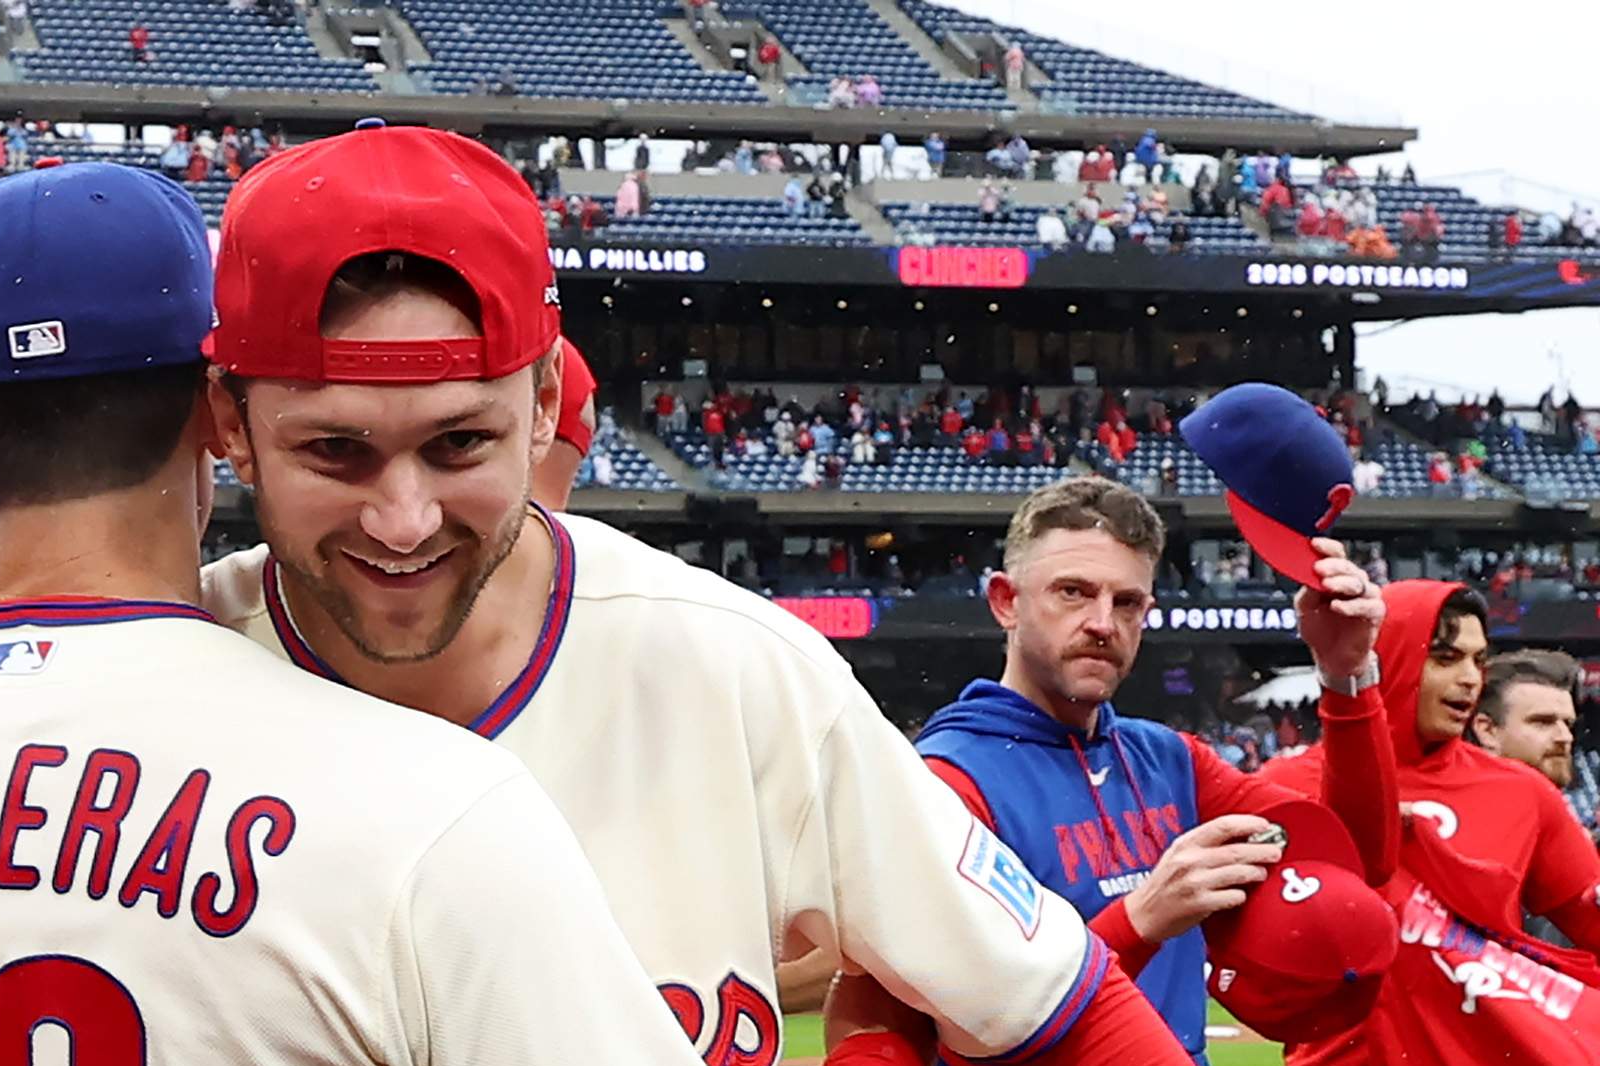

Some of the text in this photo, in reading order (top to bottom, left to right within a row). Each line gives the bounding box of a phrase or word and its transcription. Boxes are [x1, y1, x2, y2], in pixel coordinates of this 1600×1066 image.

[588, 248, 706, 272] PHILLIES
[899, 244, 1028, 288] CLINCHED
[1247, 263, 1469, 288] 2026 POSTSEASON
[1169, 608, 1297, 630] POSTSEAS
